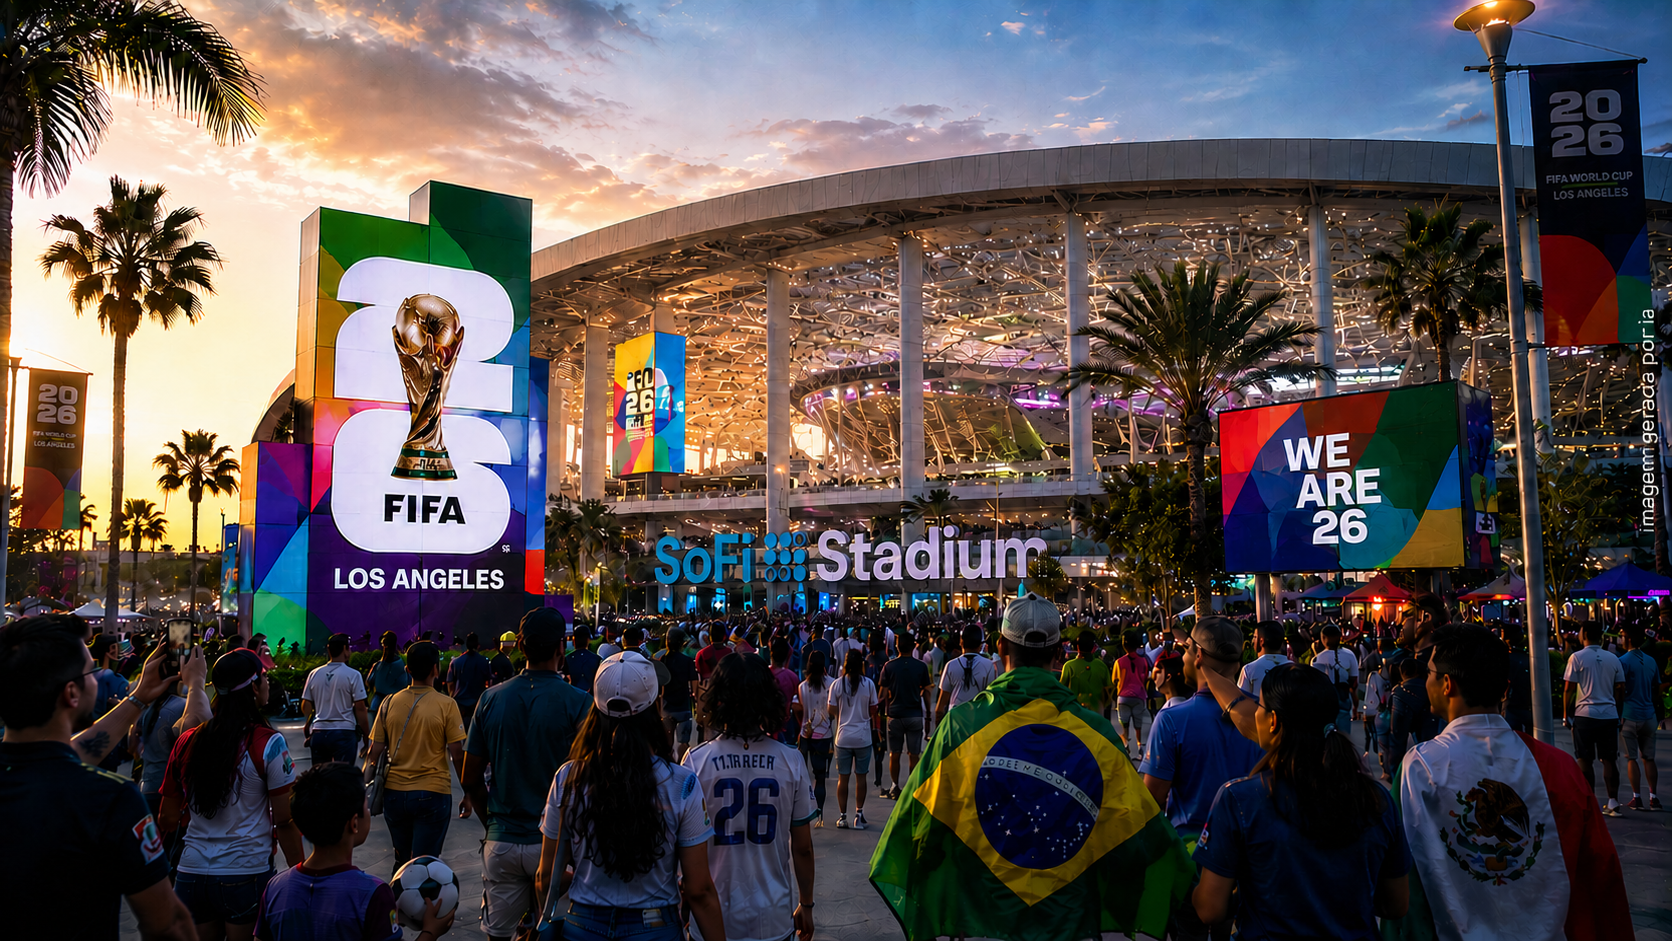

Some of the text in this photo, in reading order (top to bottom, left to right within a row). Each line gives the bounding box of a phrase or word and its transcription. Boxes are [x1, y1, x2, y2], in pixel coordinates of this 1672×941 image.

[1549, 89, 1622, 123] 20
[1551, 122, 1624, 158] 26
[1546, 170, 1633, 184] FIFA WORLD CUP
[1553, 187, 1629, 200] LOS ANGELES
[38, 383, 78, 405] 20
[625, 389, 654, 415] 26
[37, 403, 77, 425] 26
[1283, 432, 1350, 472] WE
[1296, 468, 1382, 509] ARE
[384, 493, 466, 525] FIFA
[1312, 508, 1368, 545] 26
[654, 525, 1048, 585] SoFi Stadium
[334, 568, 505, 590] LOS ANGELES
[713, 777, 780, 846] 26
